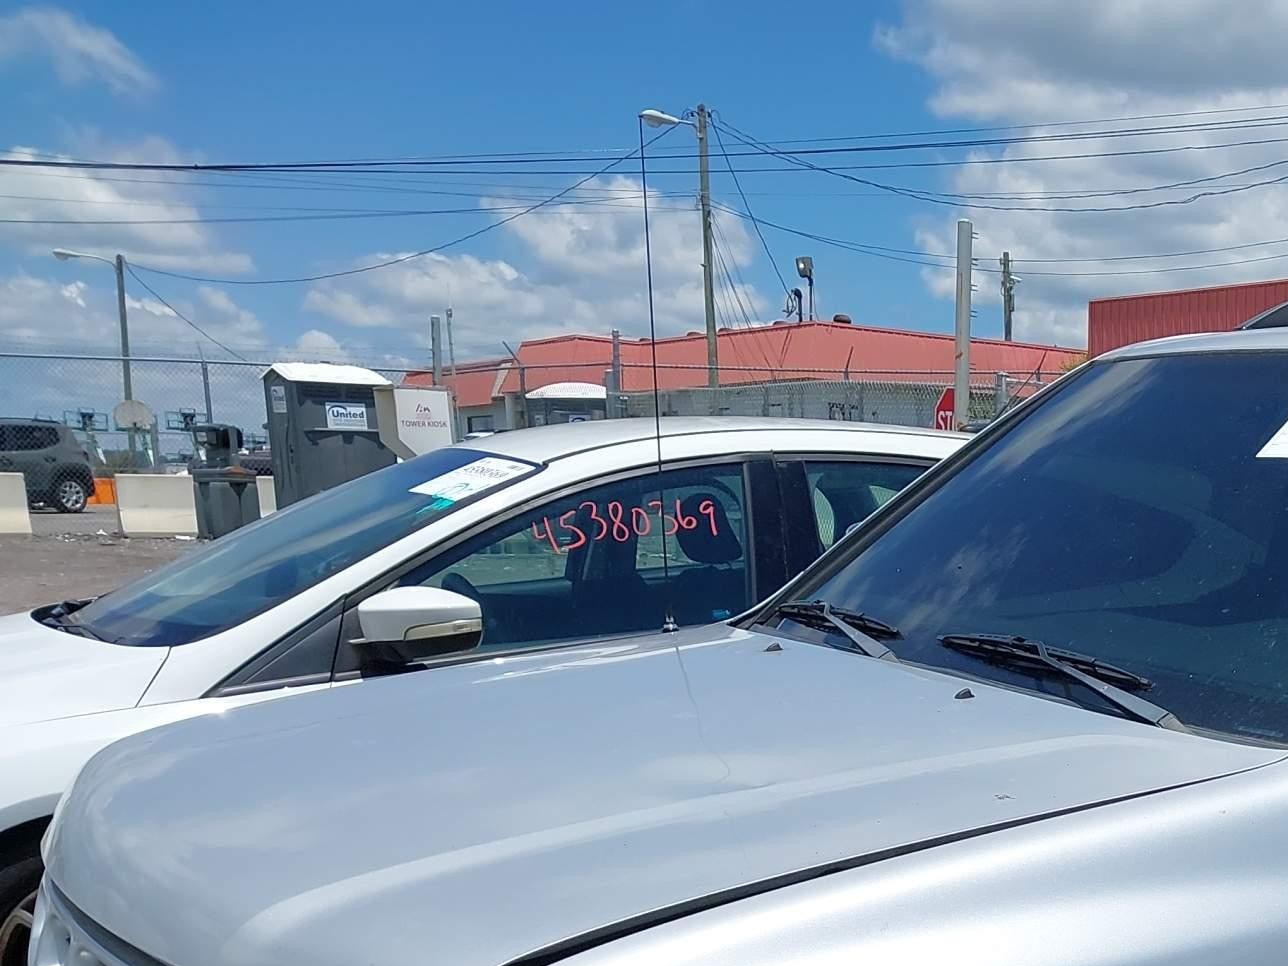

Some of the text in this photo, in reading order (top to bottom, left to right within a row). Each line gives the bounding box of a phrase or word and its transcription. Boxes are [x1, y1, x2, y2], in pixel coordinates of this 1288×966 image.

[331, 409, 365, 419] United
[401, 419, 448, 428] TOWER KIOSK
[532, 498, 718, 554] 45380369
